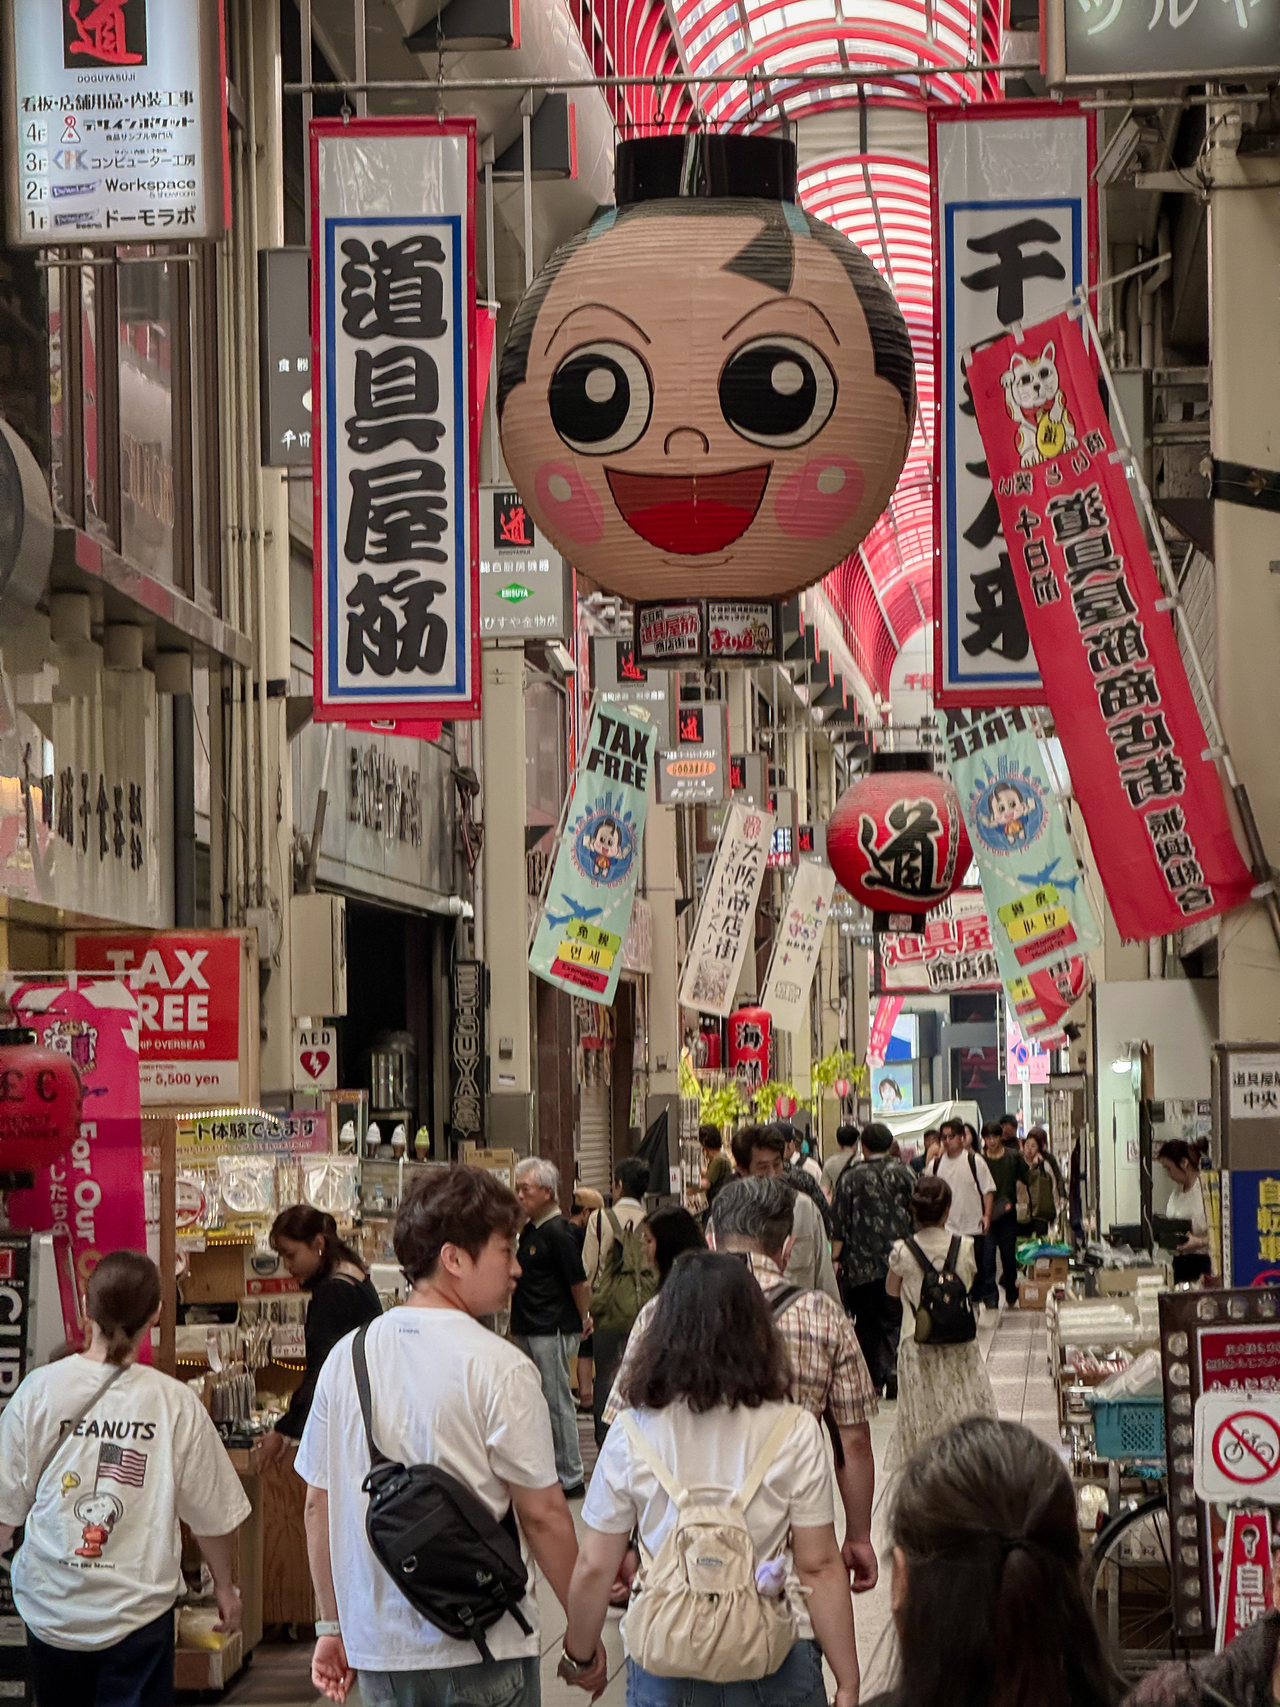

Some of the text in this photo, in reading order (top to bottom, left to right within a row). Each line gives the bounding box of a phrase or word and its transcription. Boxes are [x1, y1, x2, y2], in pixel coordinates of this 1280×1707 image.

[77, 73, 136, 83] DOGUYASUJI
[91, 153, 196, 170] コンピューター工房
[105, 177, 196, 193] Workspace
[106, 205, 197, 229] ドーモラボ
[341, 235, 449, 676] 道具屋筋
[501, 588, 529, 598] EBISUYA
[480, 615, 558, 630] びすや金物店
[641, 613, 700, 645] 道具屋筋
[597, 712, 650, 766] TAX
[586, 747, 648, 792] FREE
[859, 798, 950, 897] 道
[715, 842, 763, 963] 大阪商店街
[570, 945, 600, 966] 면세
[107, 949, 211, 990] TAX
[561, 961, 600, 983] Exemption
[138, 994, 209, 1031] REE
[154, 1039, 206, 1050] OVERSEAS
[299, 1031, 331, 1047] AED
[195, 1073, 219, 1087] yen
[1243, 1090, 1279, 1110] 中央
[71, 1121, 102, 1244] For Our
[59, 1419, 157, 1441] PEANUTS
